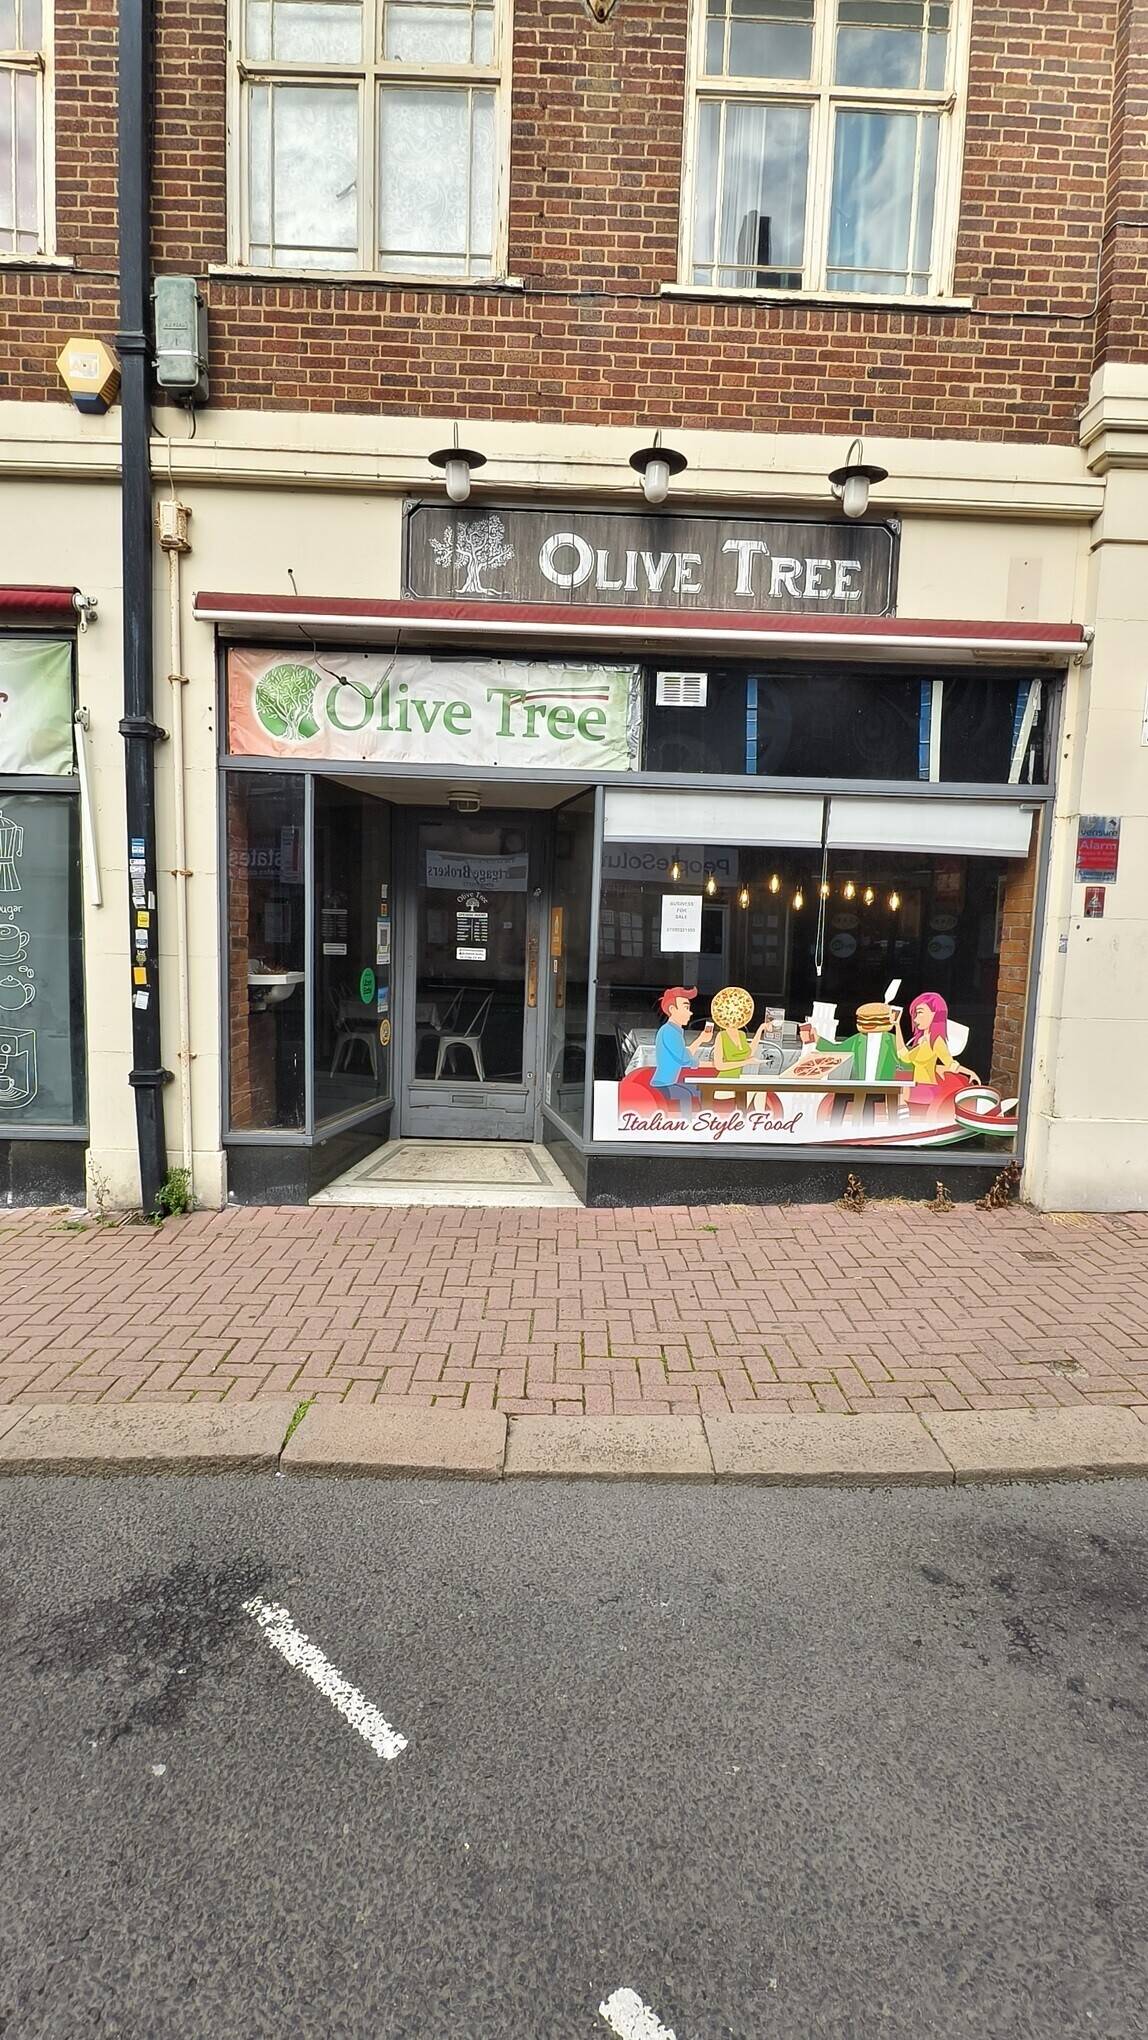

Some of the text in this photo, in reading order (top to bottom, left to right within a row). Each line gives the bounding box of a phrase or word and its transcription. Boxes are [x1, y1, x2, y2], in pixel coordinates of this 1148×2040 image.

[538, 532, 863, 600] OLIVE TREE
[325, 680, 607, 742] Olive Tree
[1079, 839, 1117, 850] Alarm
[456, 891, 488, 905] Olive Tree
[0, 904, 23, 920] ugar
[618, 1111, 804, 1141] Italian Style Food
